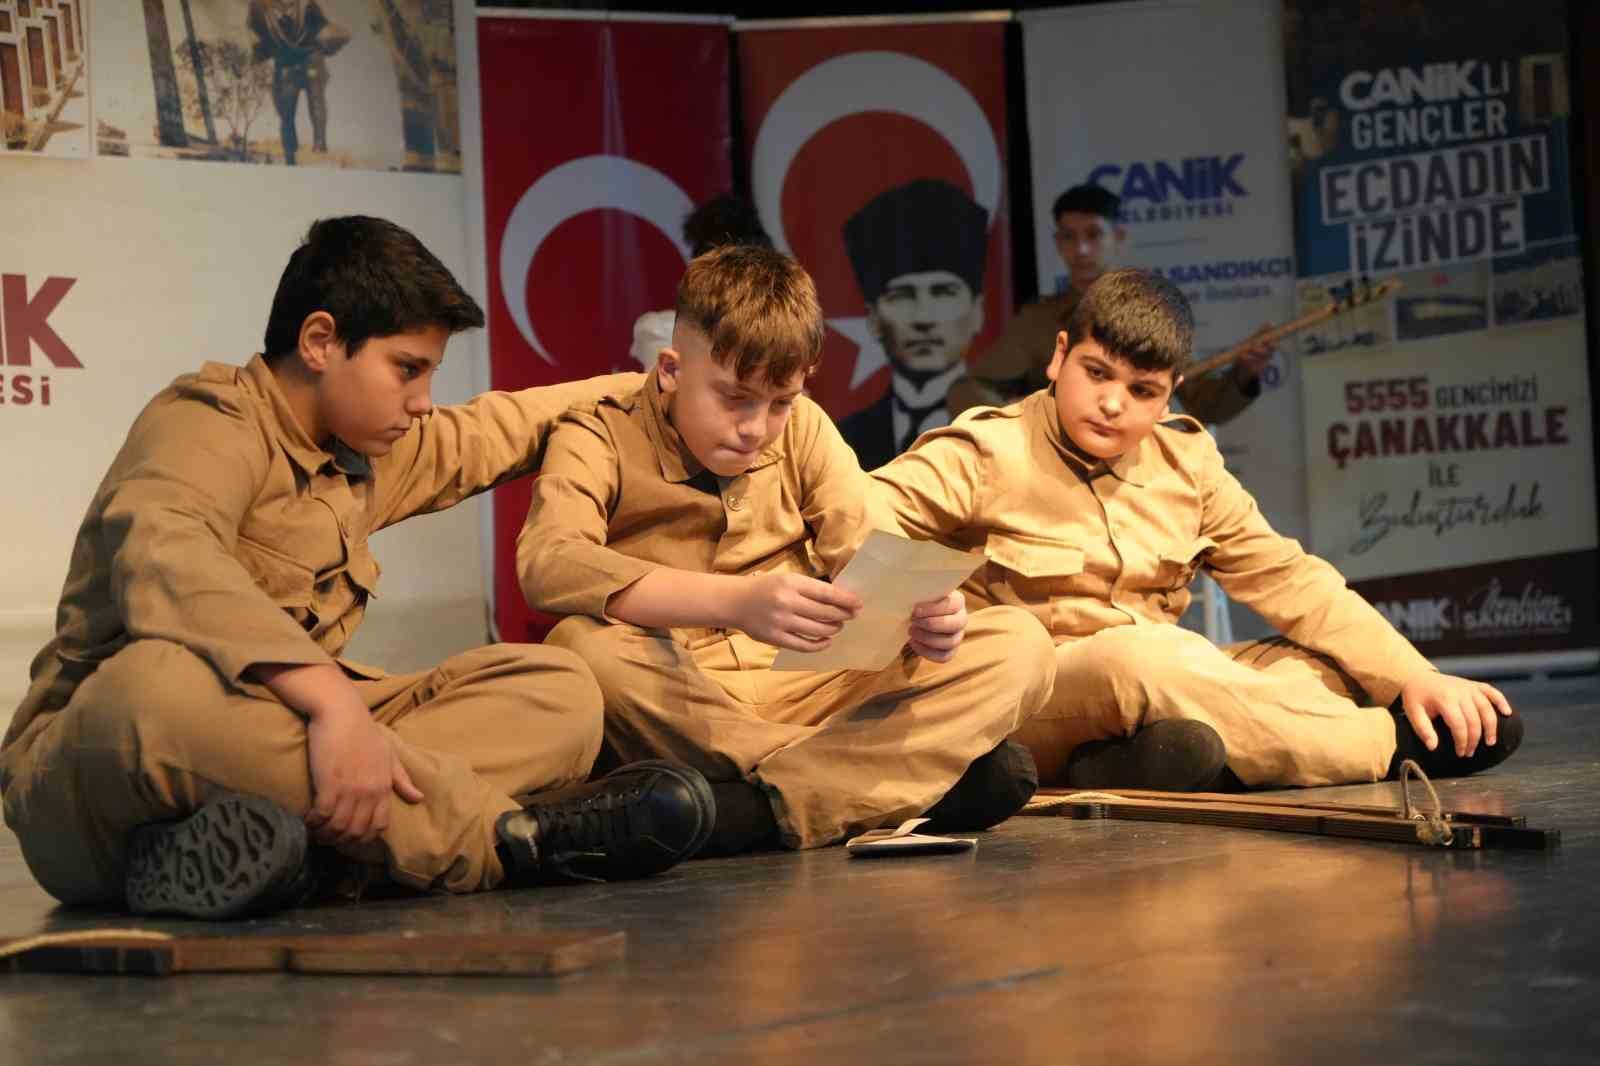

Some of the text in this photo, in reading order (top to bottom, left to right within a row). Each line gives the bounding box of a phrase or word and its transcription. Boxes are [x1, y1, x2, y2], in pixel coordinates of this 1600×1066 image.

[1325, 138, 1543, 219] ECDADIN
[0, 273, 85, 369] K
[1344, 376, 1430, 415] 5555
[1327, 406, 1569, 470] ÇANAKKALE
